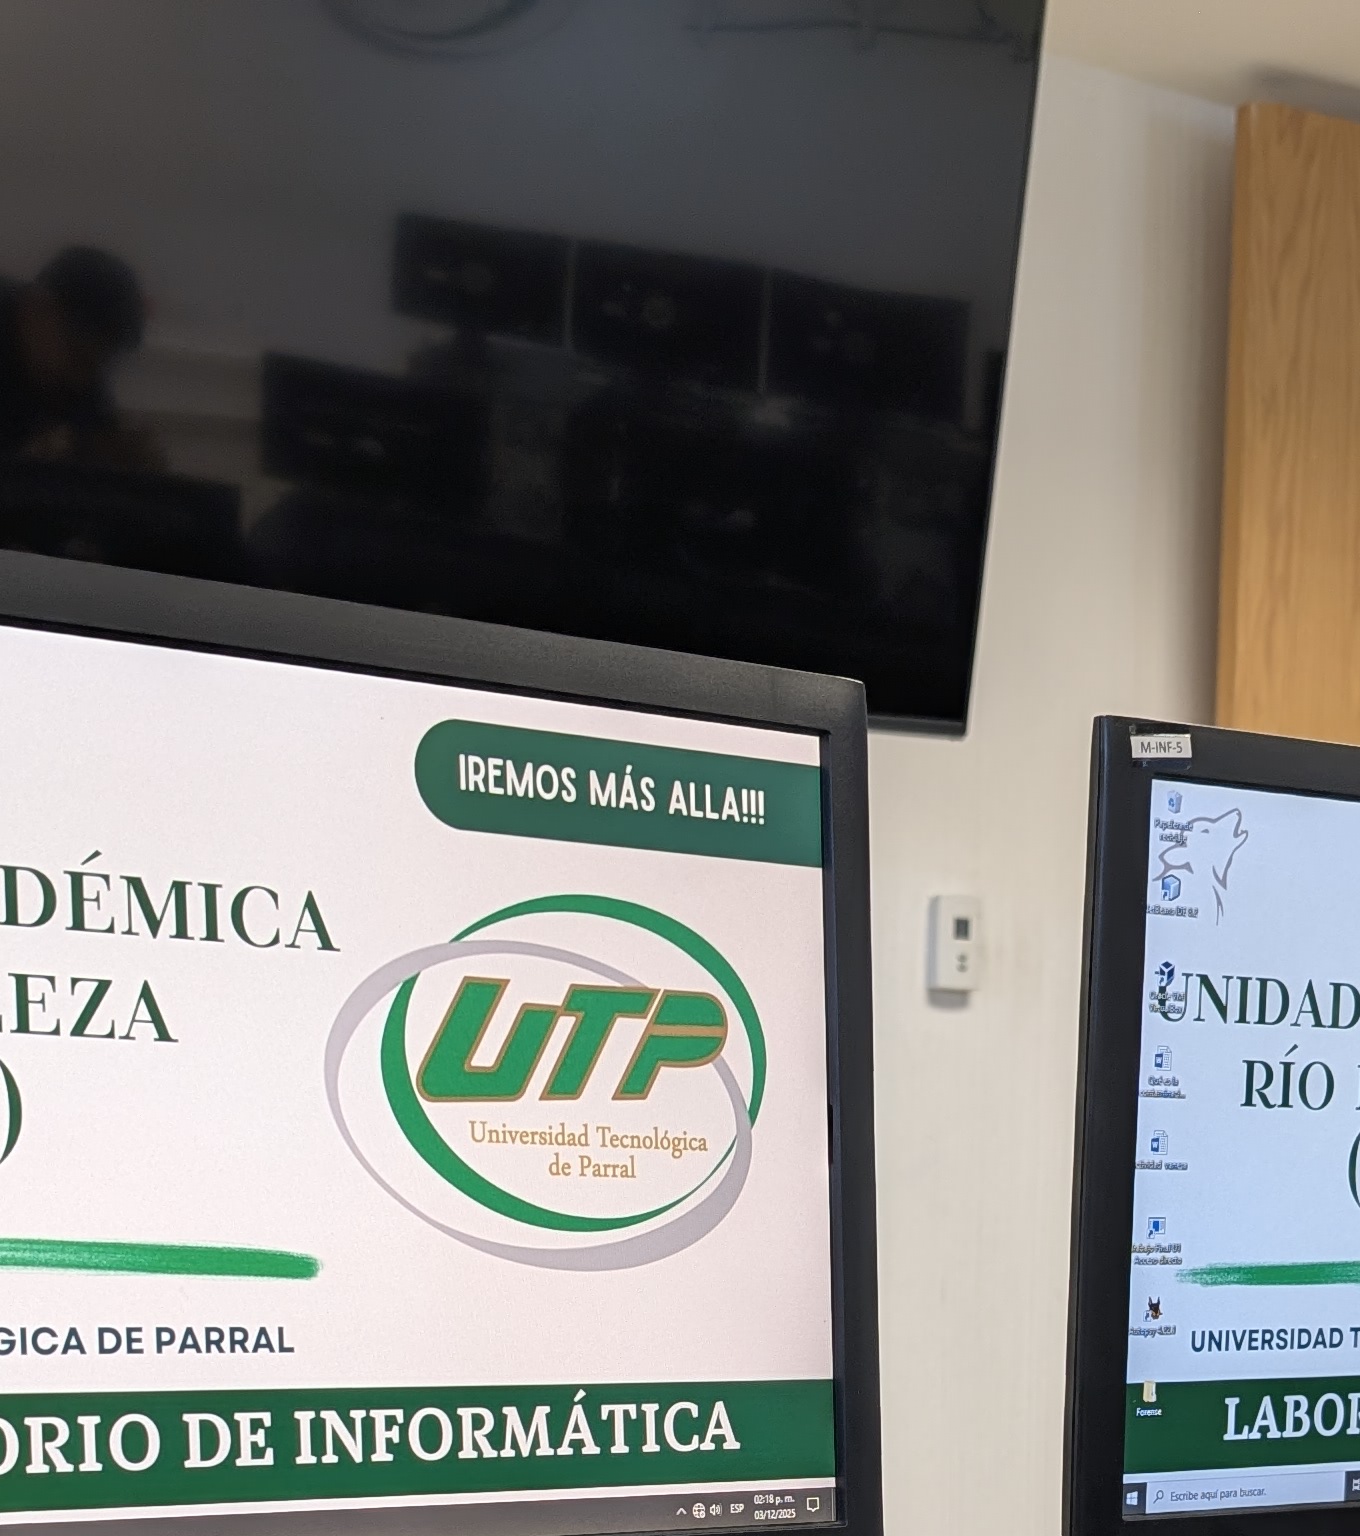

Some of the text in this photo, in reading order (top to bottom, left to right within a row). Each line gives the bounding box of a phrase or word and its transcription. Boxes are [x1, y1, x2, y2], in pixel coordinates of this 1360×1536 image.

[1140, 741, 1184, 755] M-INF-5
[457, 752, 766, 826] IREMOS MÁS ALLA!!!
[416, 975, 729, 1102] UTP
[1240, 1043, 1335, 1111] RÍO
[468, 1119, 709, 1160] Universidad Tecnológica
[548, 1154, 637, 1179] de Parral
[97, 1327, 145, 1355] DE
[155, 1325, 295, 1355] PARRAL
[1191, 1327, 1344, 1353] UNIVERSIDAD
[182, 1409, 274, 1470] DE
[295, 1389, 741, 1466] INFORMÁTICA
[753, 1494, 774, 1506] 02:18
[1170, 1486, 1267, 1503] Escribe aquí para buscar.
[729, 1503, 745, 1515] ESP
[753, 1508, 797, 1520] 03/12/2025
